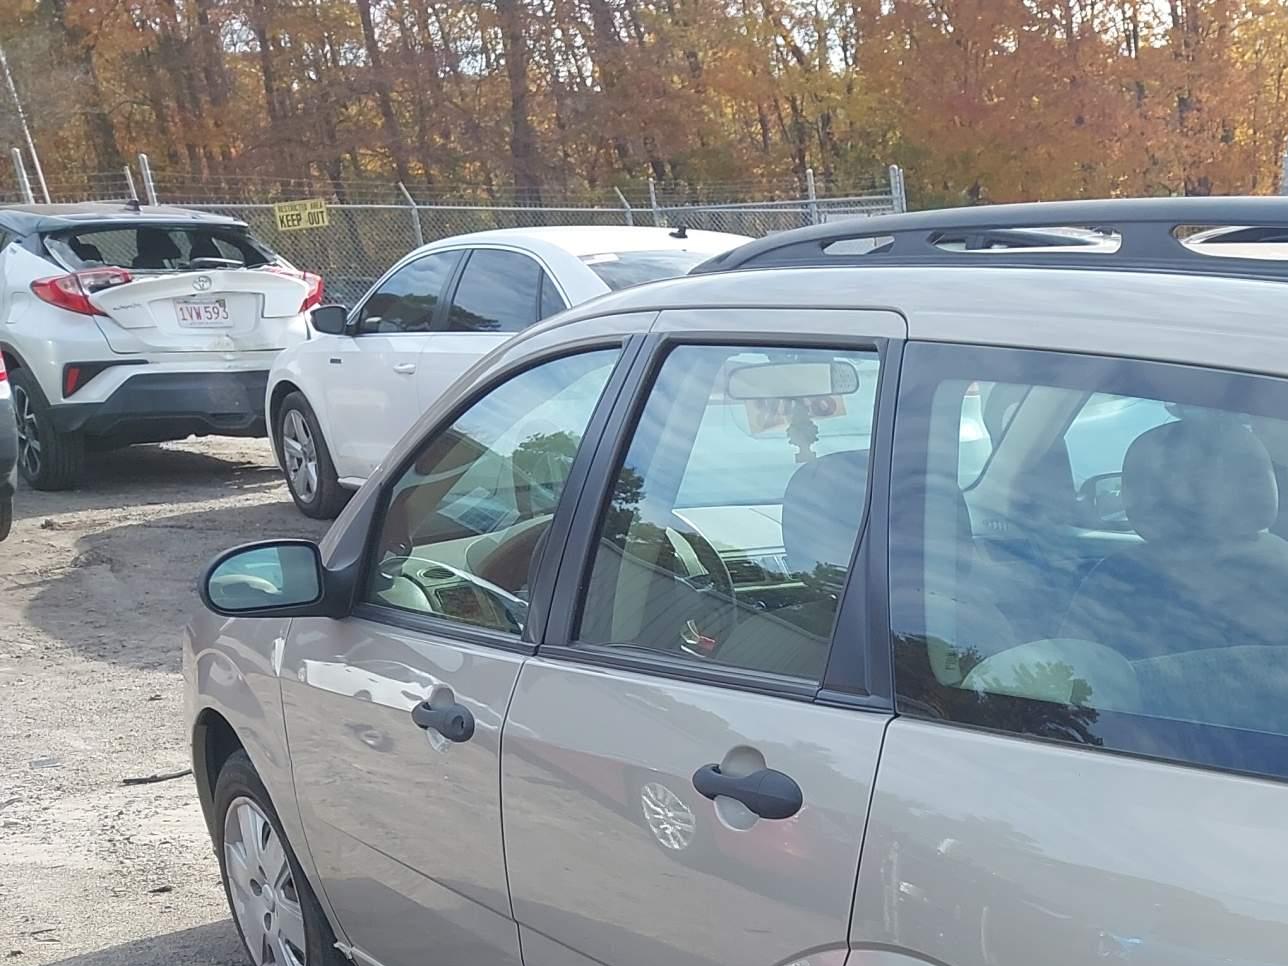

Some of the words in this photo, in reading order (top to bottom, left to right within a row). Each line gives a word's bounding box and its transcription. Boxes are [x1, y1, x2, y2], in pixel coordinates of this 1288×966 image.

[279, 213, 302, 228] KEEP
[307, 211, 325, 225] OUT
[204, 304, 229, 320] 593
